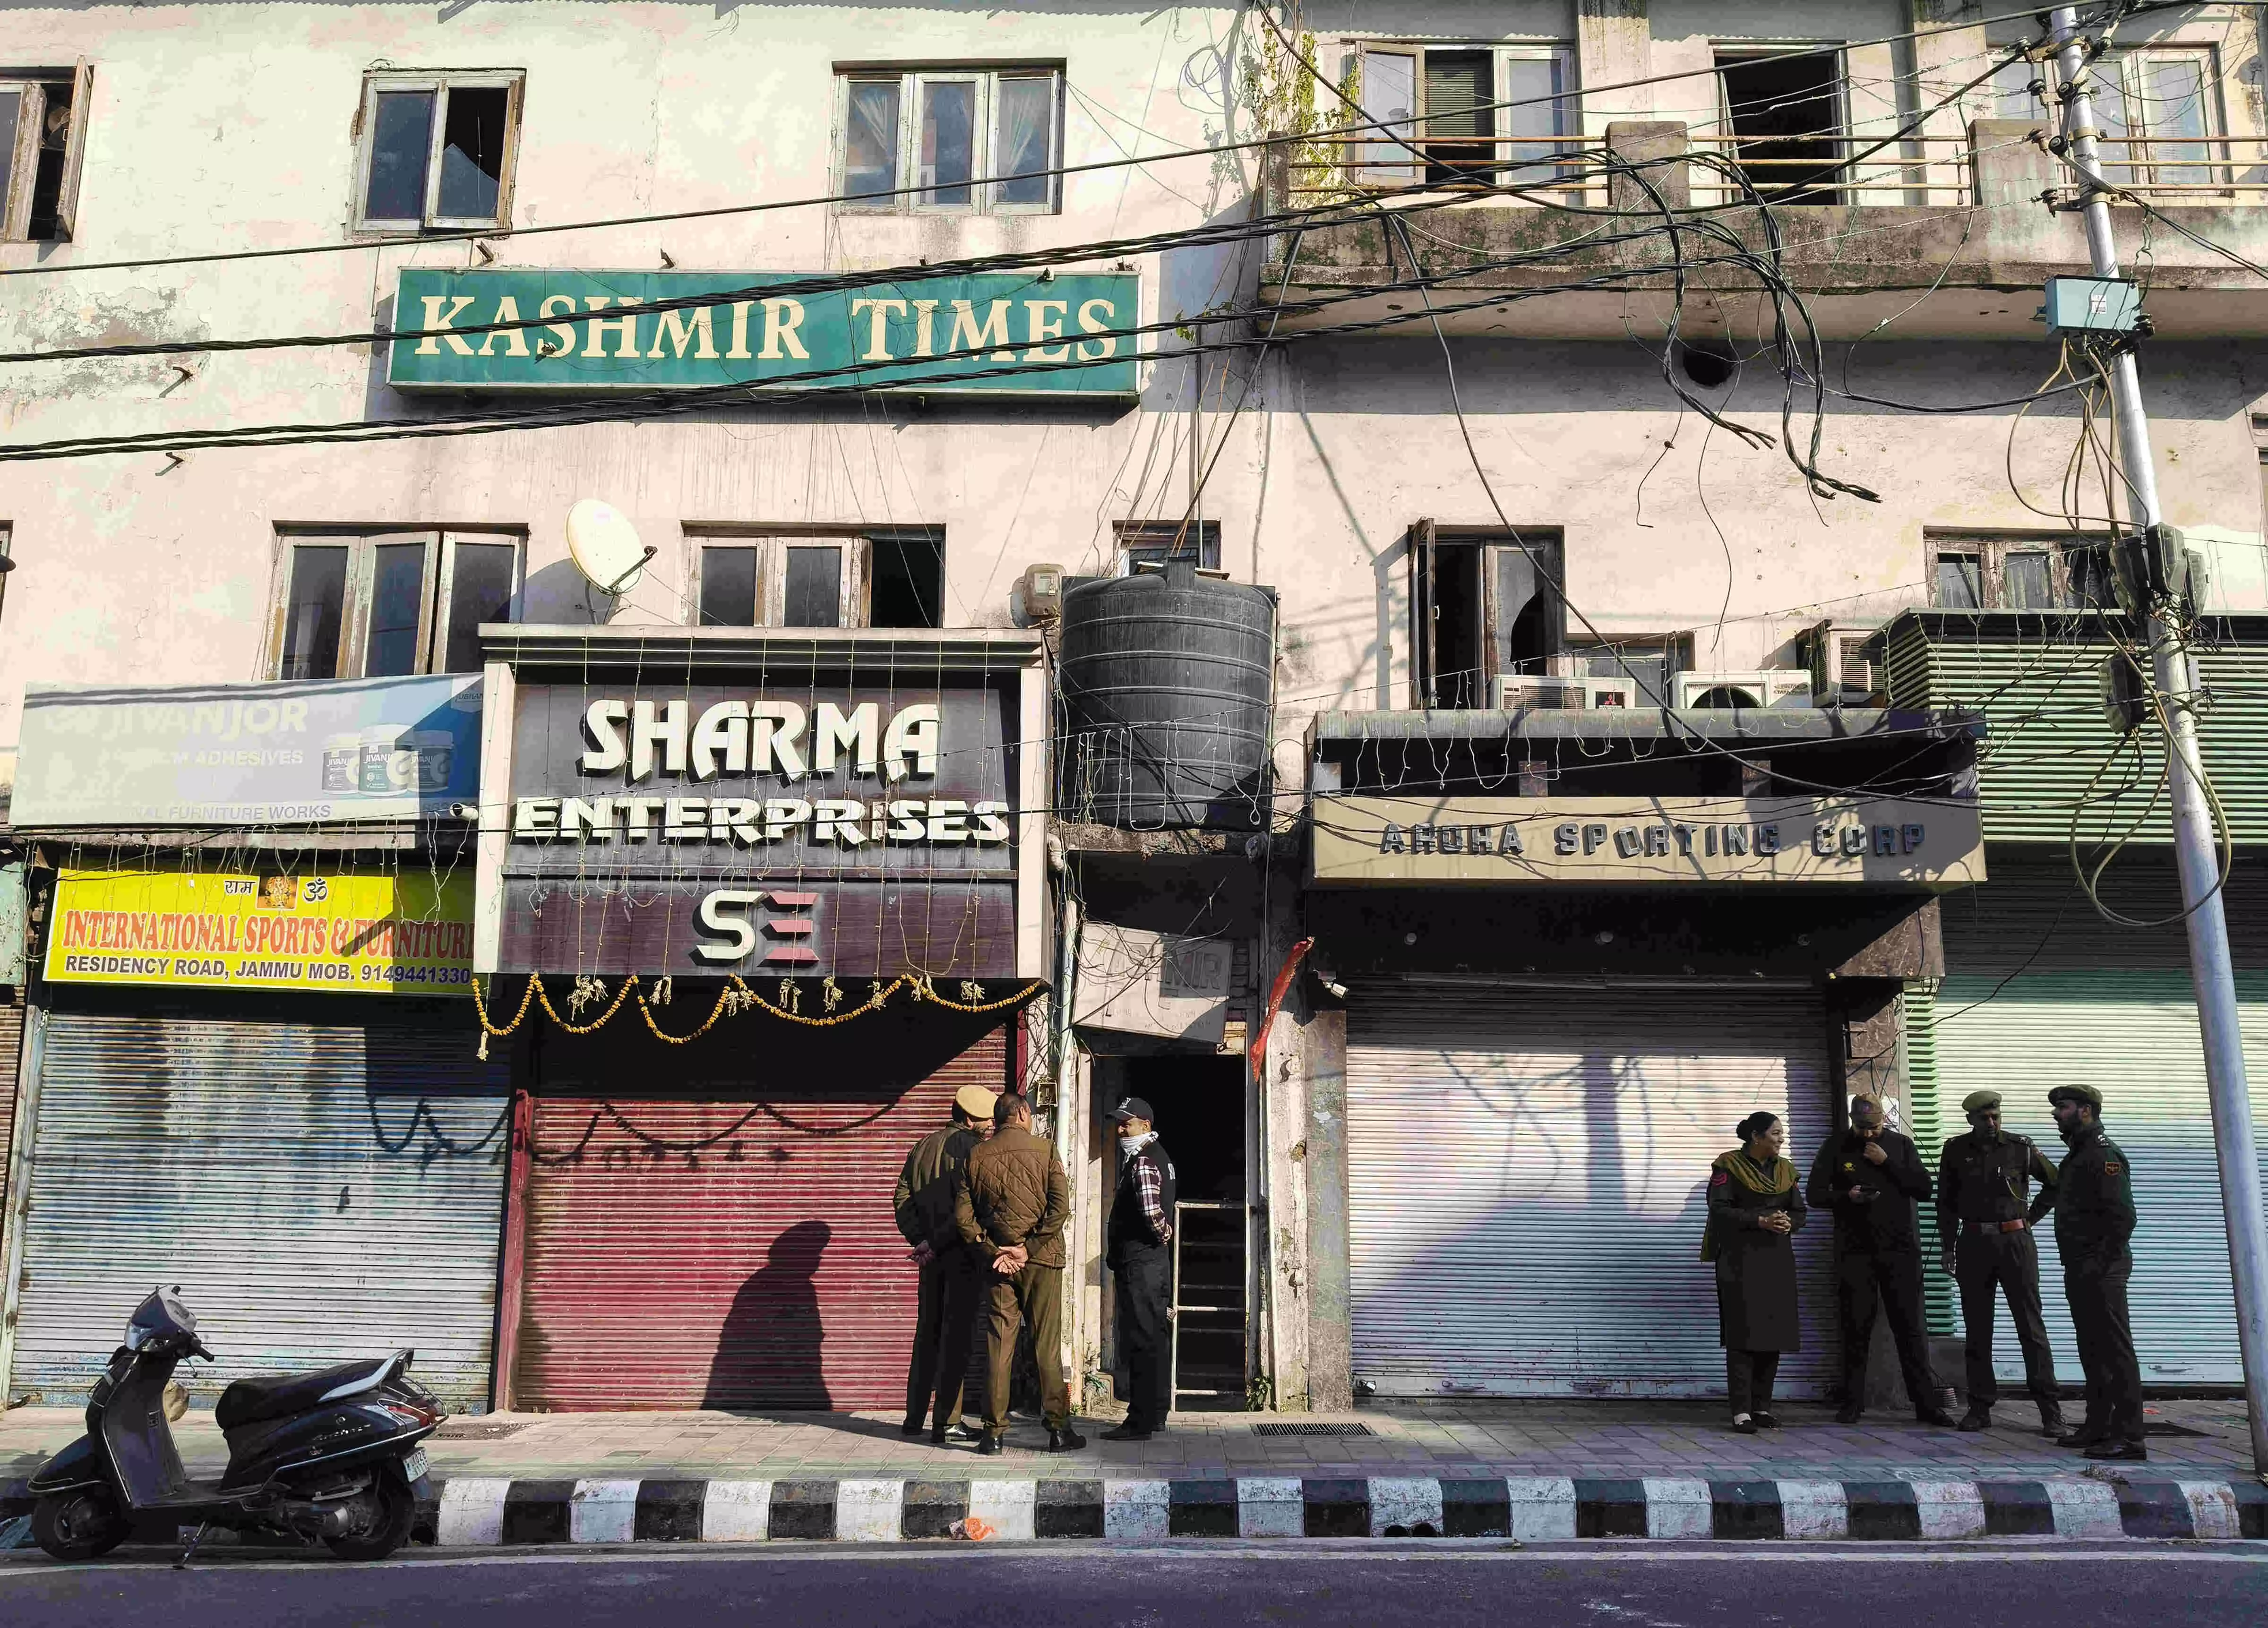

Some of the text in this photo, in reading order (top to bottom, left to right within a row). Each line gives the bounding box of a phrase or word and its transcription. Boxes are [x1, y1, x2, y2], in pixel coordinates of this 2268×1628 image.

[414, 295, 1117, 363] KASHMIR TIMES
[196, 751, 304, 765] ADHESIVES
[582, 699, 939, 782] SHARMA
[169, 805, 264, 820] FURNITURE
[269, 804, 332, 819] WORKS
[514, 797, 1011, 843] ENTERPRISES
[1380, 823, 1925, 858] ARORA SPORTING CORP
[224, 880, 256, 894] राम
[63, 910, 238, 952] INTERNATIONAL
[243, 916, 327, 955] SPORTS
[331, 917, 350, 955] &
[65, 955, 471, 984] RESIDENCY ROAD, JAMMU MOB. 9149441330
